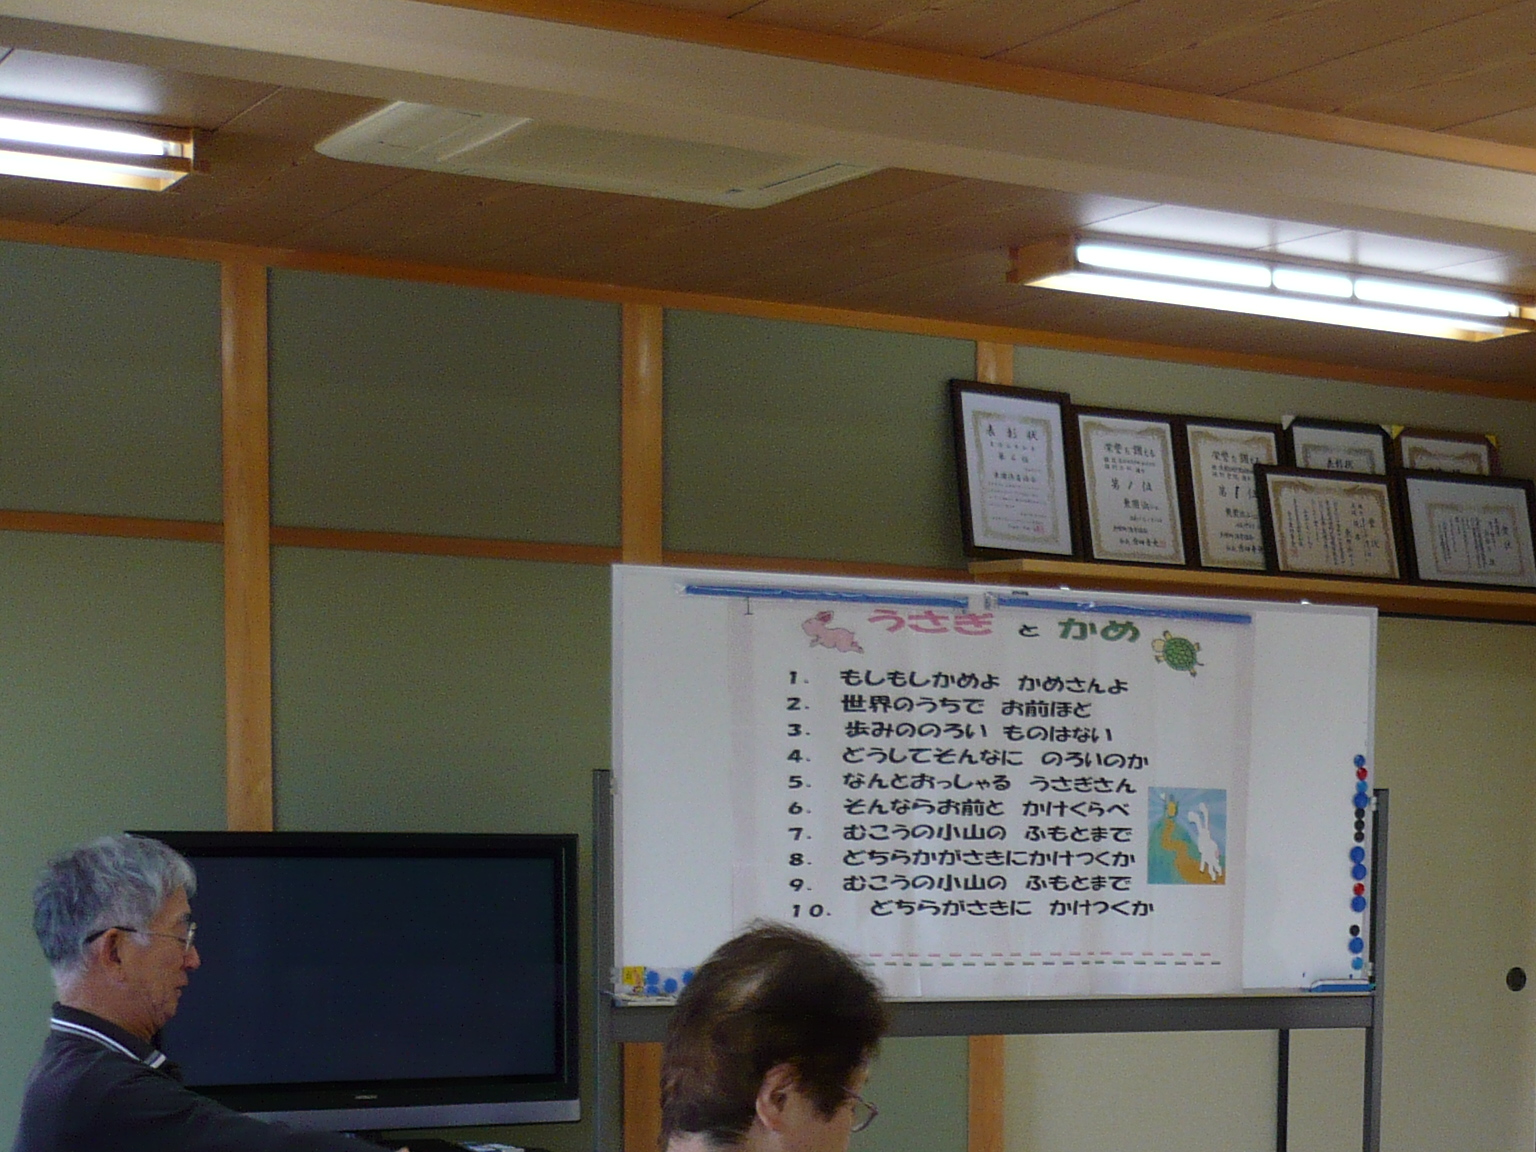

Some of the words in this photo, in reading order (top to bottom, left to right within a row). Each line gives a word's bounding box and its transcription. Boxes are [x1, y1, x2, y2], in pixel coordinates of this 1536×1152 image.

[868, 608, 994, 636] うさぎ
[1018, 623, 1041, 639] と
[1057, 617, 1142, 644] かめ
[839, 668, 1001, 691] もしもしかめよ
[1017, 674, 1129, 695] かめさんよ
[840, 693, 985, 715] 世界のうちで
[1000, 699, 1092, 719] お前ほど
[844, 719, 988, 740] 歩みののろい
[1002, 724, 1113, 744] ものはない
[841, 746, 1024, 767] どうしてそんなに
[1040, 751, 1150, 771] のろいのか
[842, 772, 1012, 792] なんとおっしゃる
[1028, 775, 1138, 795] うさぎさん
[843, 797, 1005, 817] そんならお前と
[1021, 799, 1130, 818] かけくらべ
[842, 822, 1007, 842] むこうの小山の
[1024, 825, 1133, 843] ふもとまで
[842, 848, 1136, 868] どちらかがさきにかけつくか
[842, 873, 1008, 892] むこうの小山の
[1025, 874, 1133, 892] ふもとまで
[869, 898, 1033, 917] どちらがさきに
[1048, 899, 1155, 917] かけつくか
